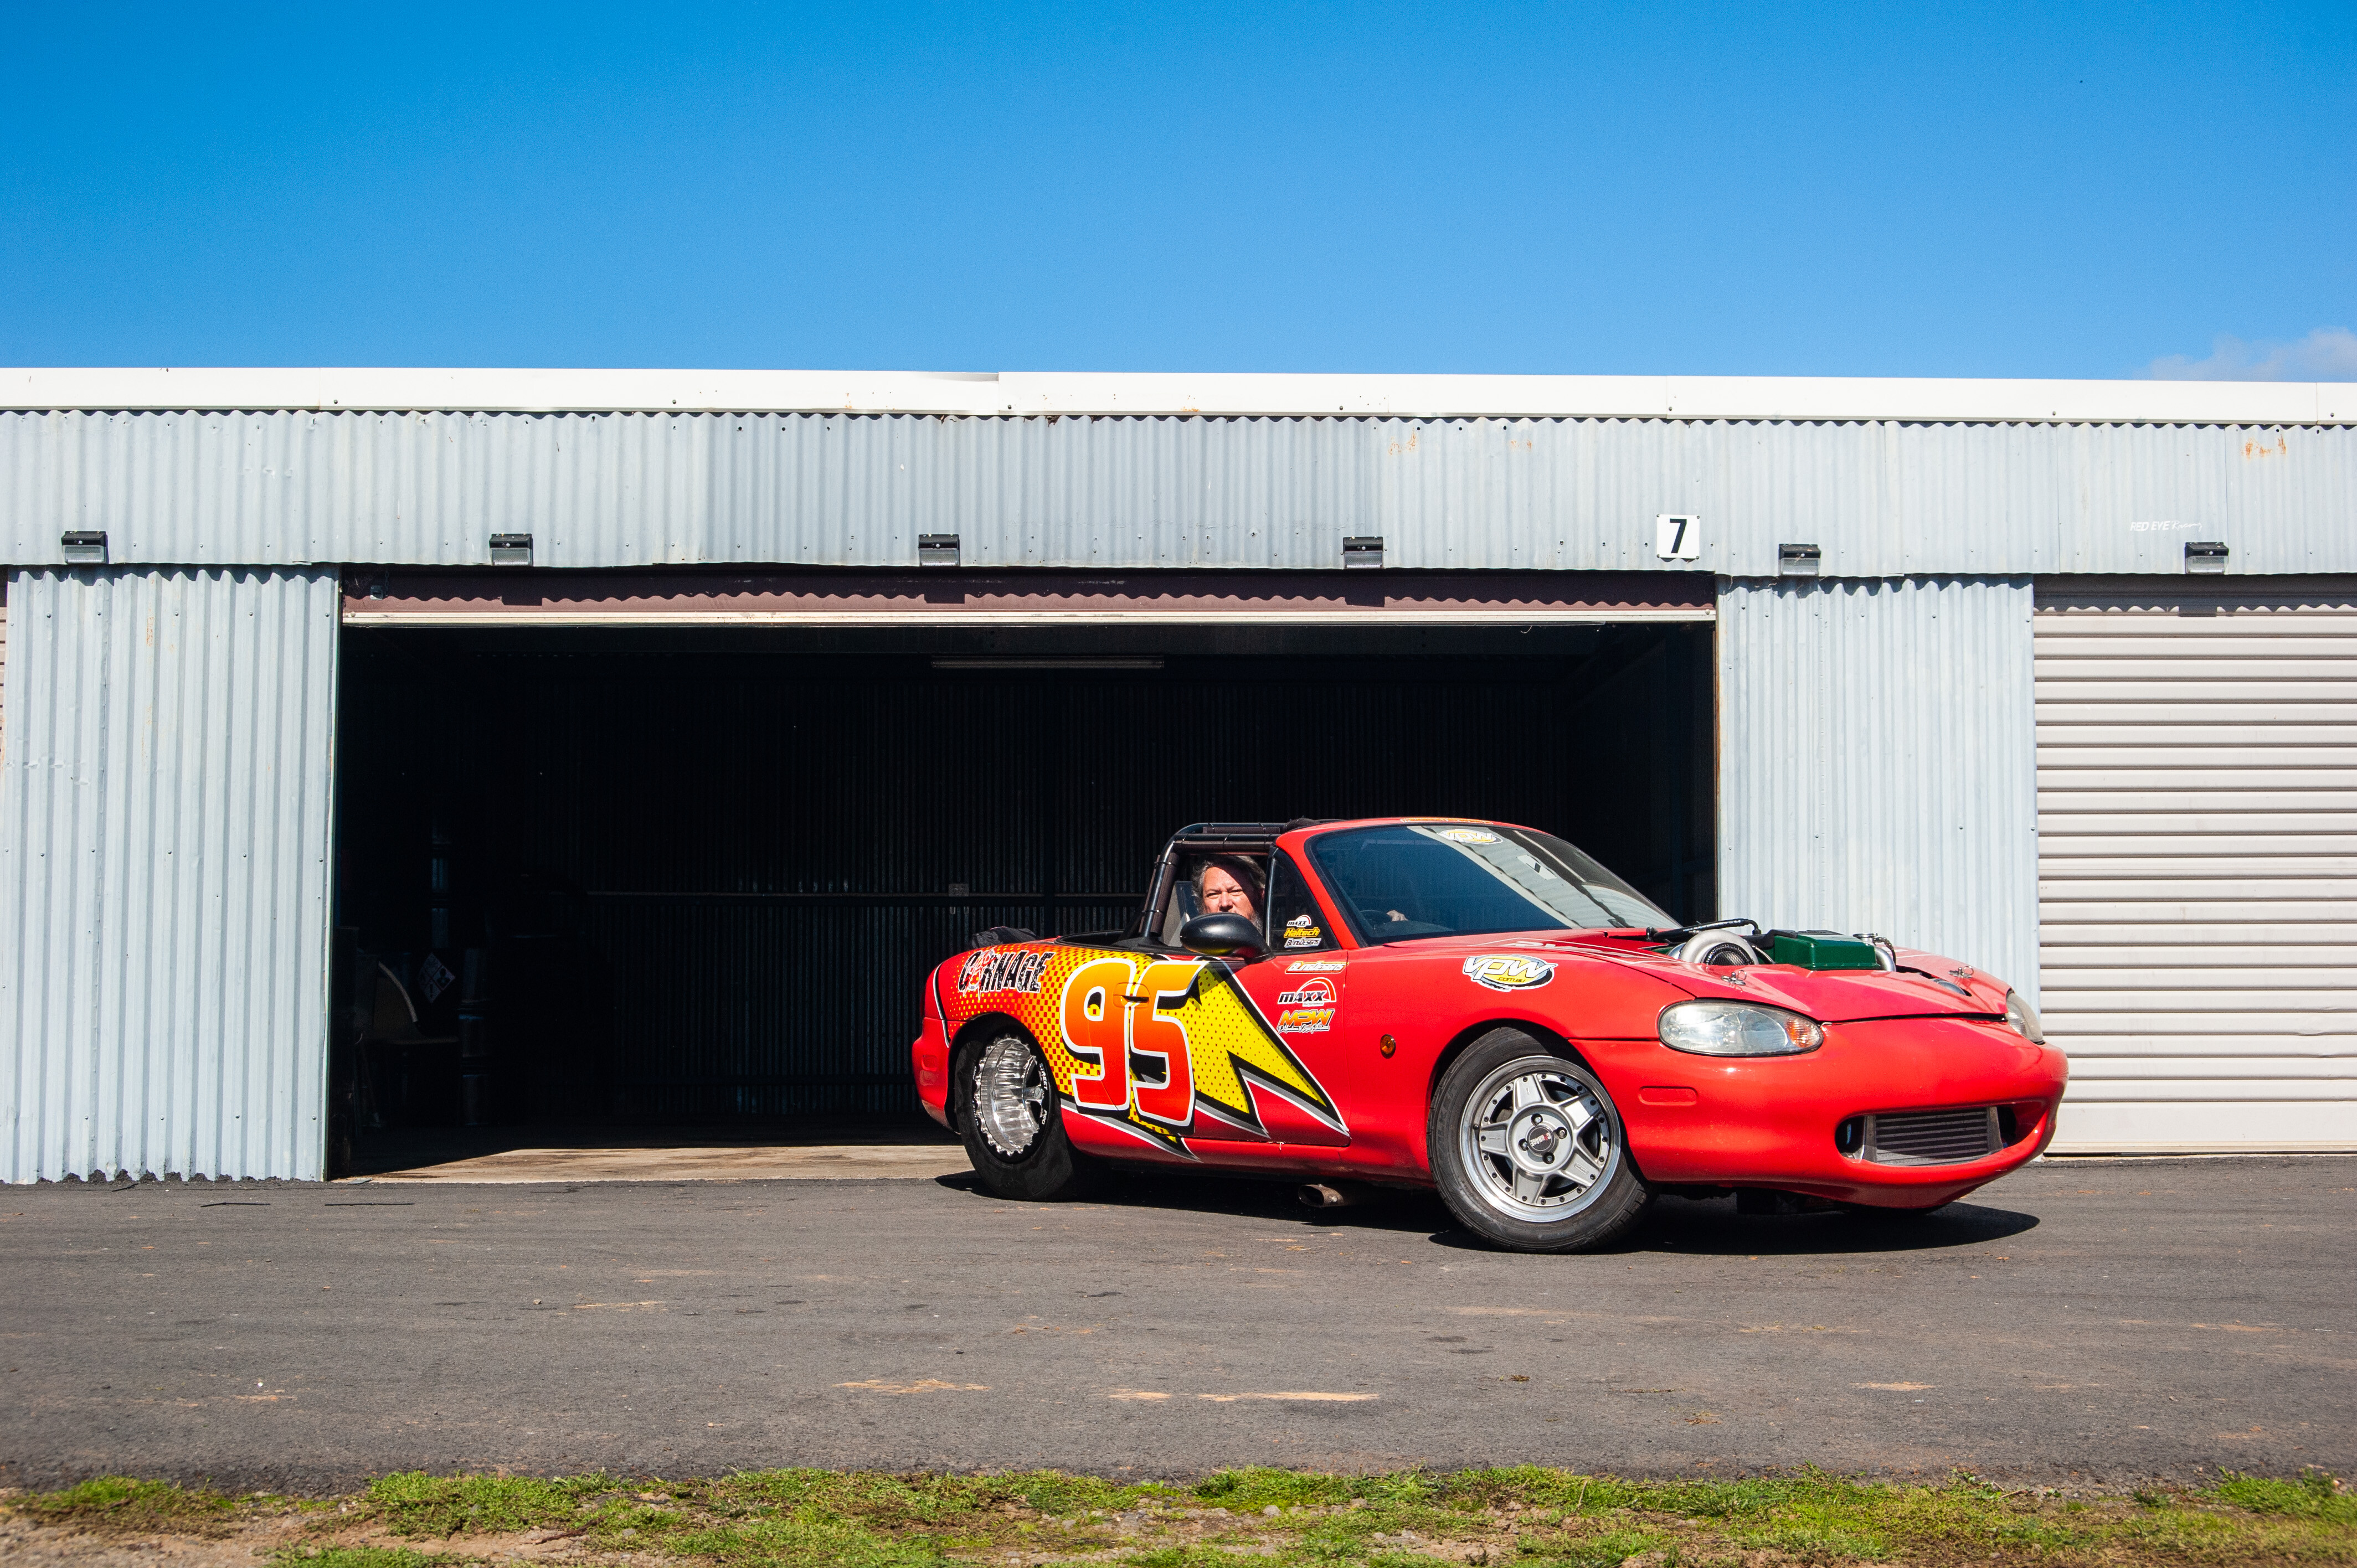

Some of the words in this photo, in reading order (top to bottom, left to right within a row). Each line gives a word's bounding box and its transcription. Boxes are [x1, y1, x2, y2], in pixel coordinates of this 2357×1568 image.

[1670, 518, 1687, 553] 7
[2130, 522, 2149, 531] RED
[2150, 520, 2170, 530] EYE
[1285, 927, 1319, 937] Haltech
[958, 948, 1056, 996] CARNAGE
[1279, 1009, 1334, 1027] MPW
[1060, 957, 1208, 1126] 95
[1039, 1062, 1048, 1091] STREET
[1530, 1132, 1551, 1146] CARNAGE
